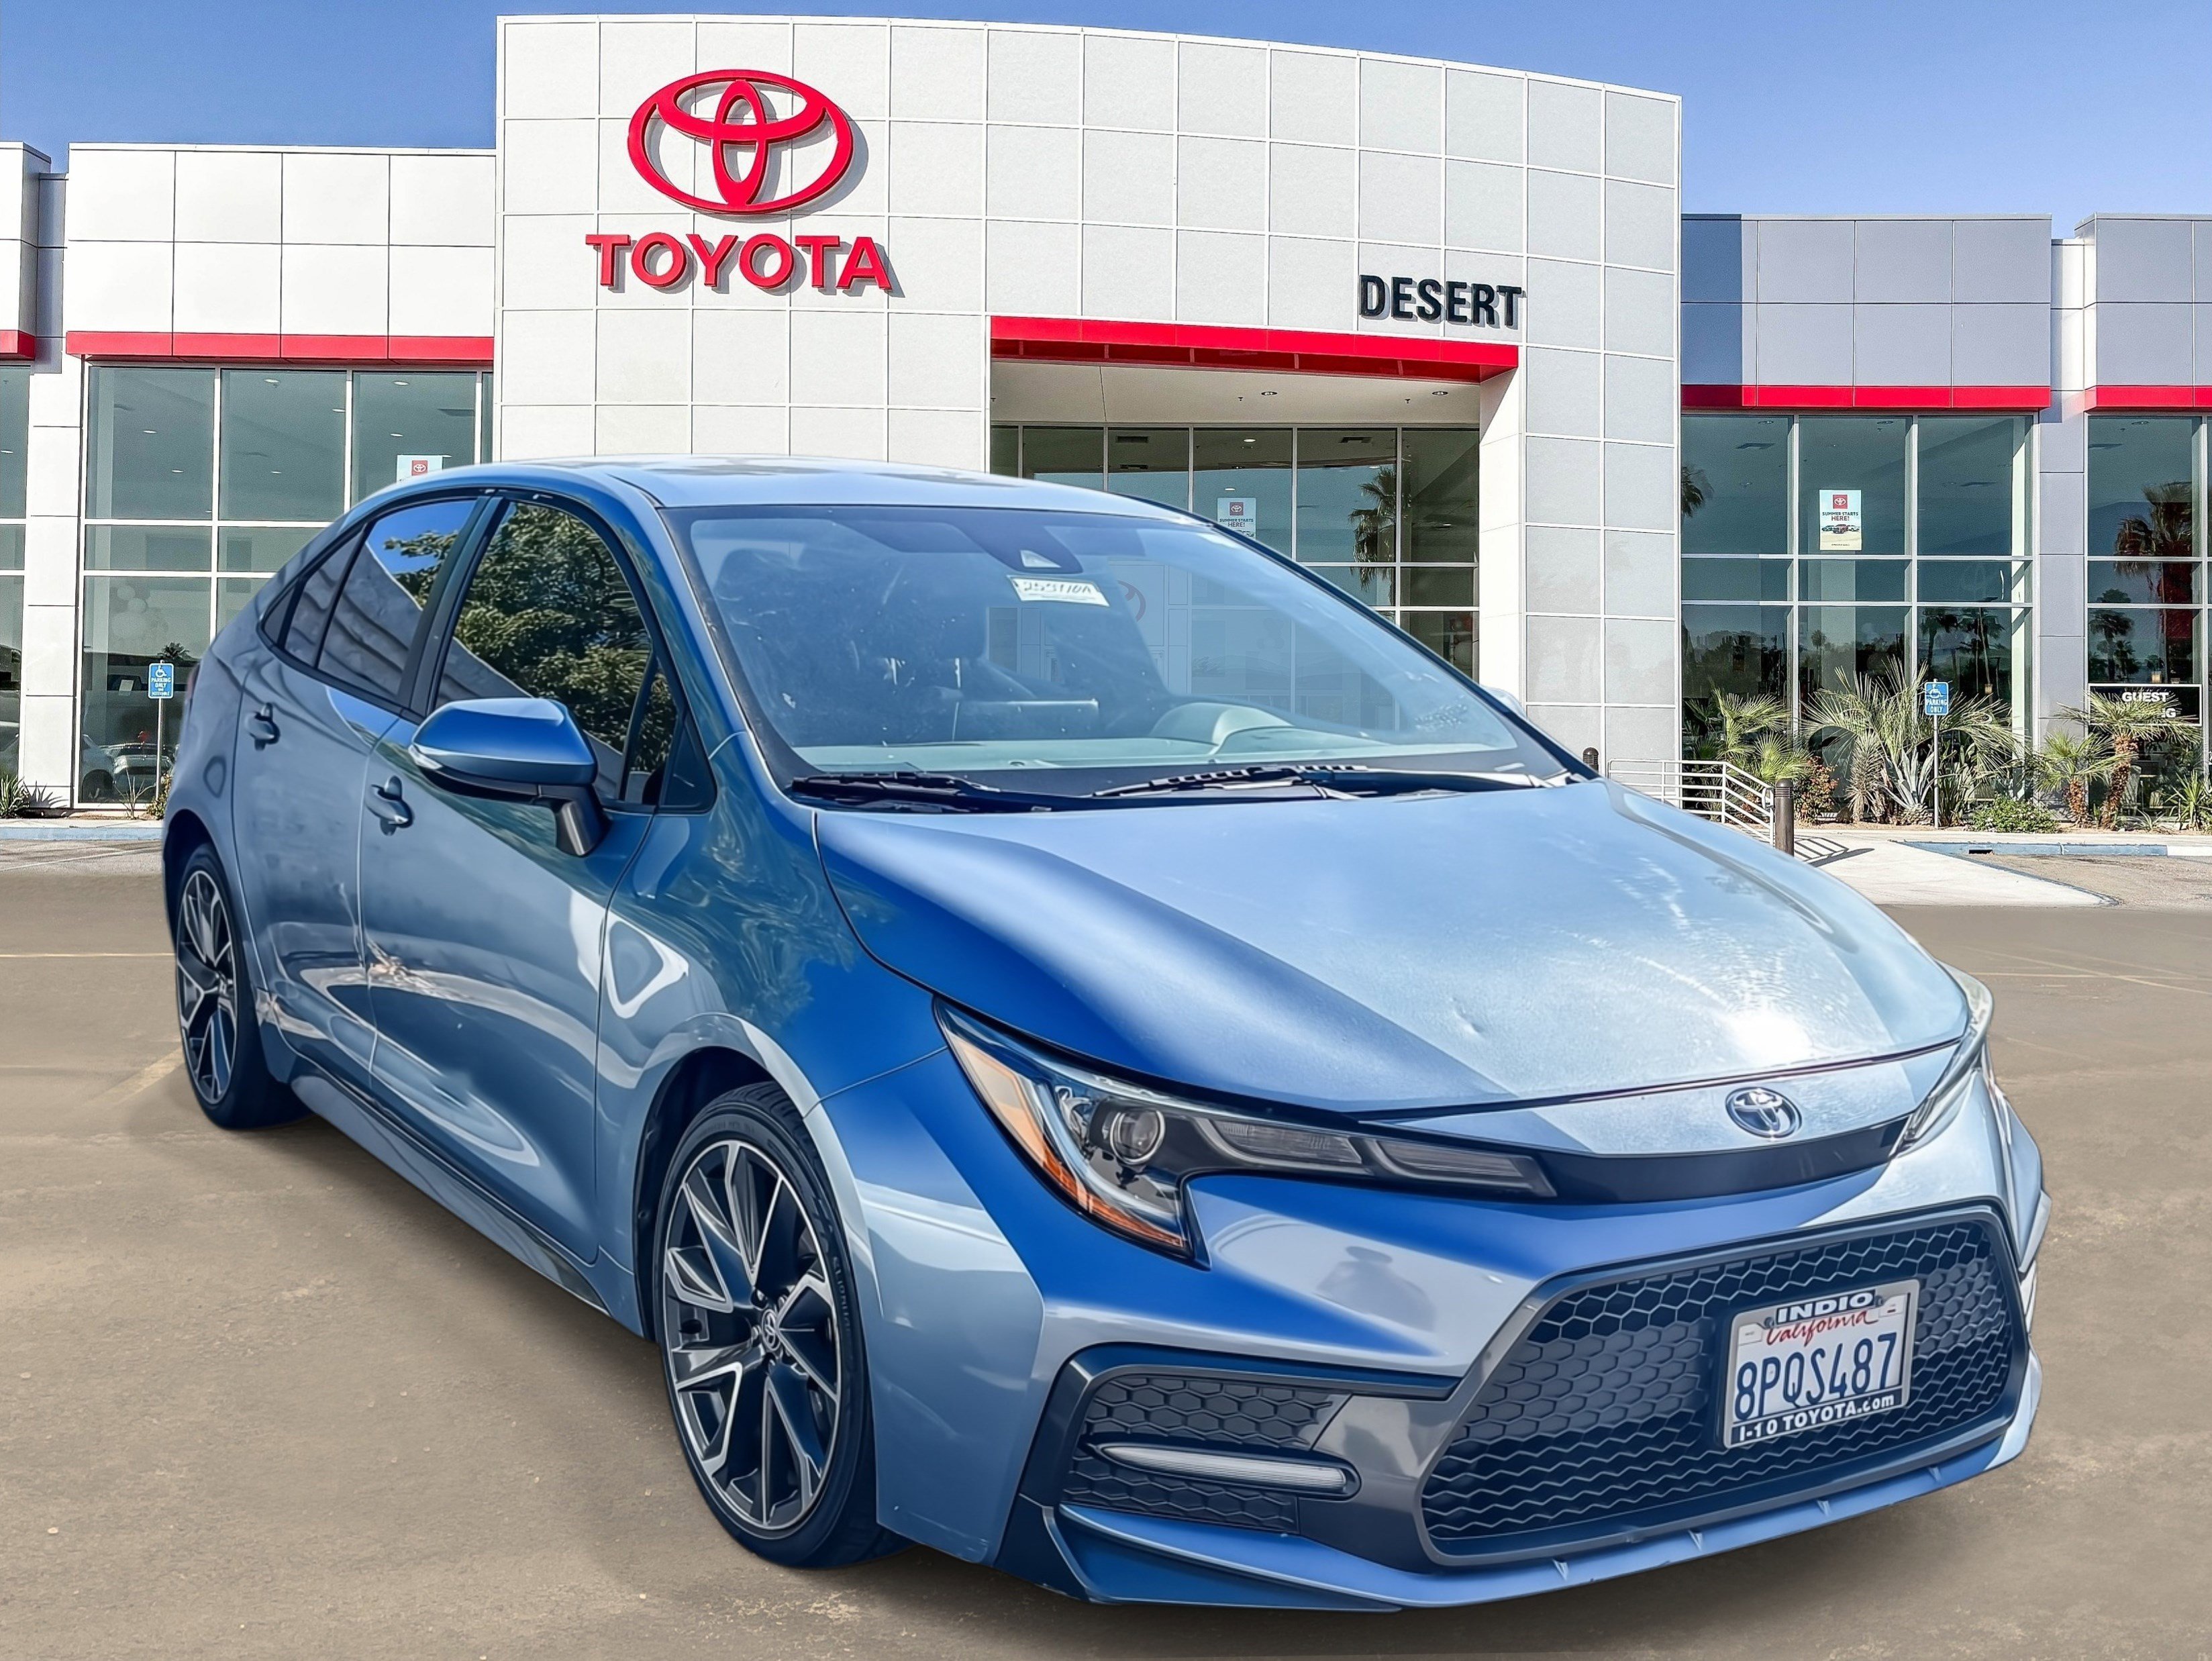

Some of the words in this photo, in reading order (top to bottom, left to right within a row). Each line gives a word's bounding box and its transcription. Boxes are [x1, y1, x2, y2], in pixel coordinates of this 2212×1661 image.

[585, 232, 893, 291] TOYOTA
[1359, 274, 1522, 327] DESERT
[1930, 705, 1944, 713] ONLY
[2121, 691, 2170, 703] GUEST
[1777, 1292, 1874, 1323] INDIO
[1733, 1331, 1898, 1421] 8PQS487
[1782, 1394, 1895, 1431] TOYOTA.com
